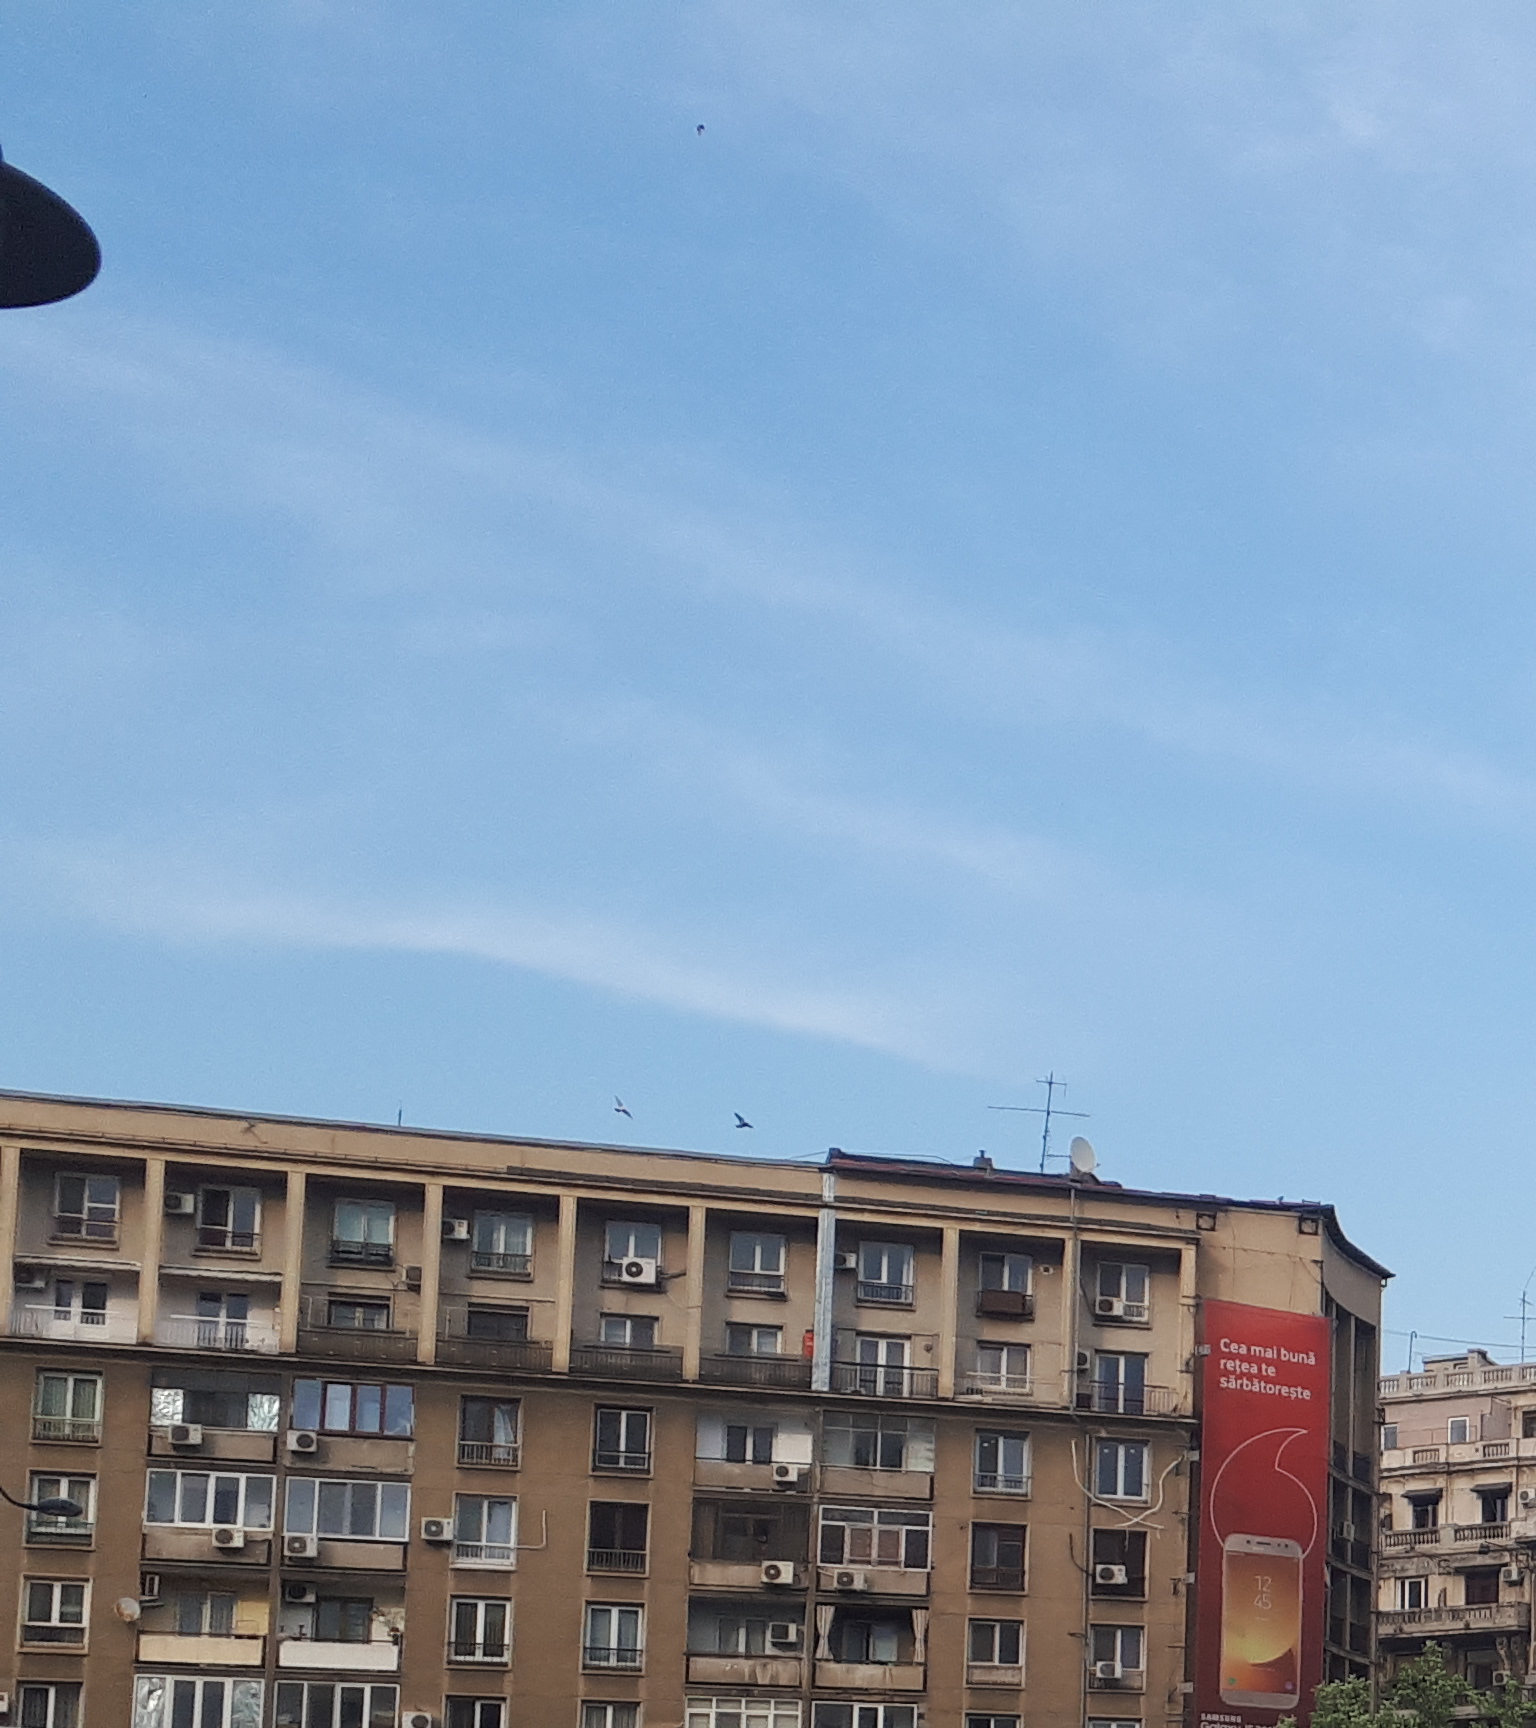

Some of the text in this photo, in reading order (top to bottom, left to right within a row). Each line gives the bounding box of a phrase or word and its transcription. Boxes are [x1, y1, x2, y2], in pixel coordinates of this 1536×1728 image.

[1220, 1338, 1316, 1365] Cea mai bună
[1261, 1363, 1276, 1376] te
[1254, 1593, 1271, 1610] 45
[1201, 1713, 1241, 1723] SAMSUNG
